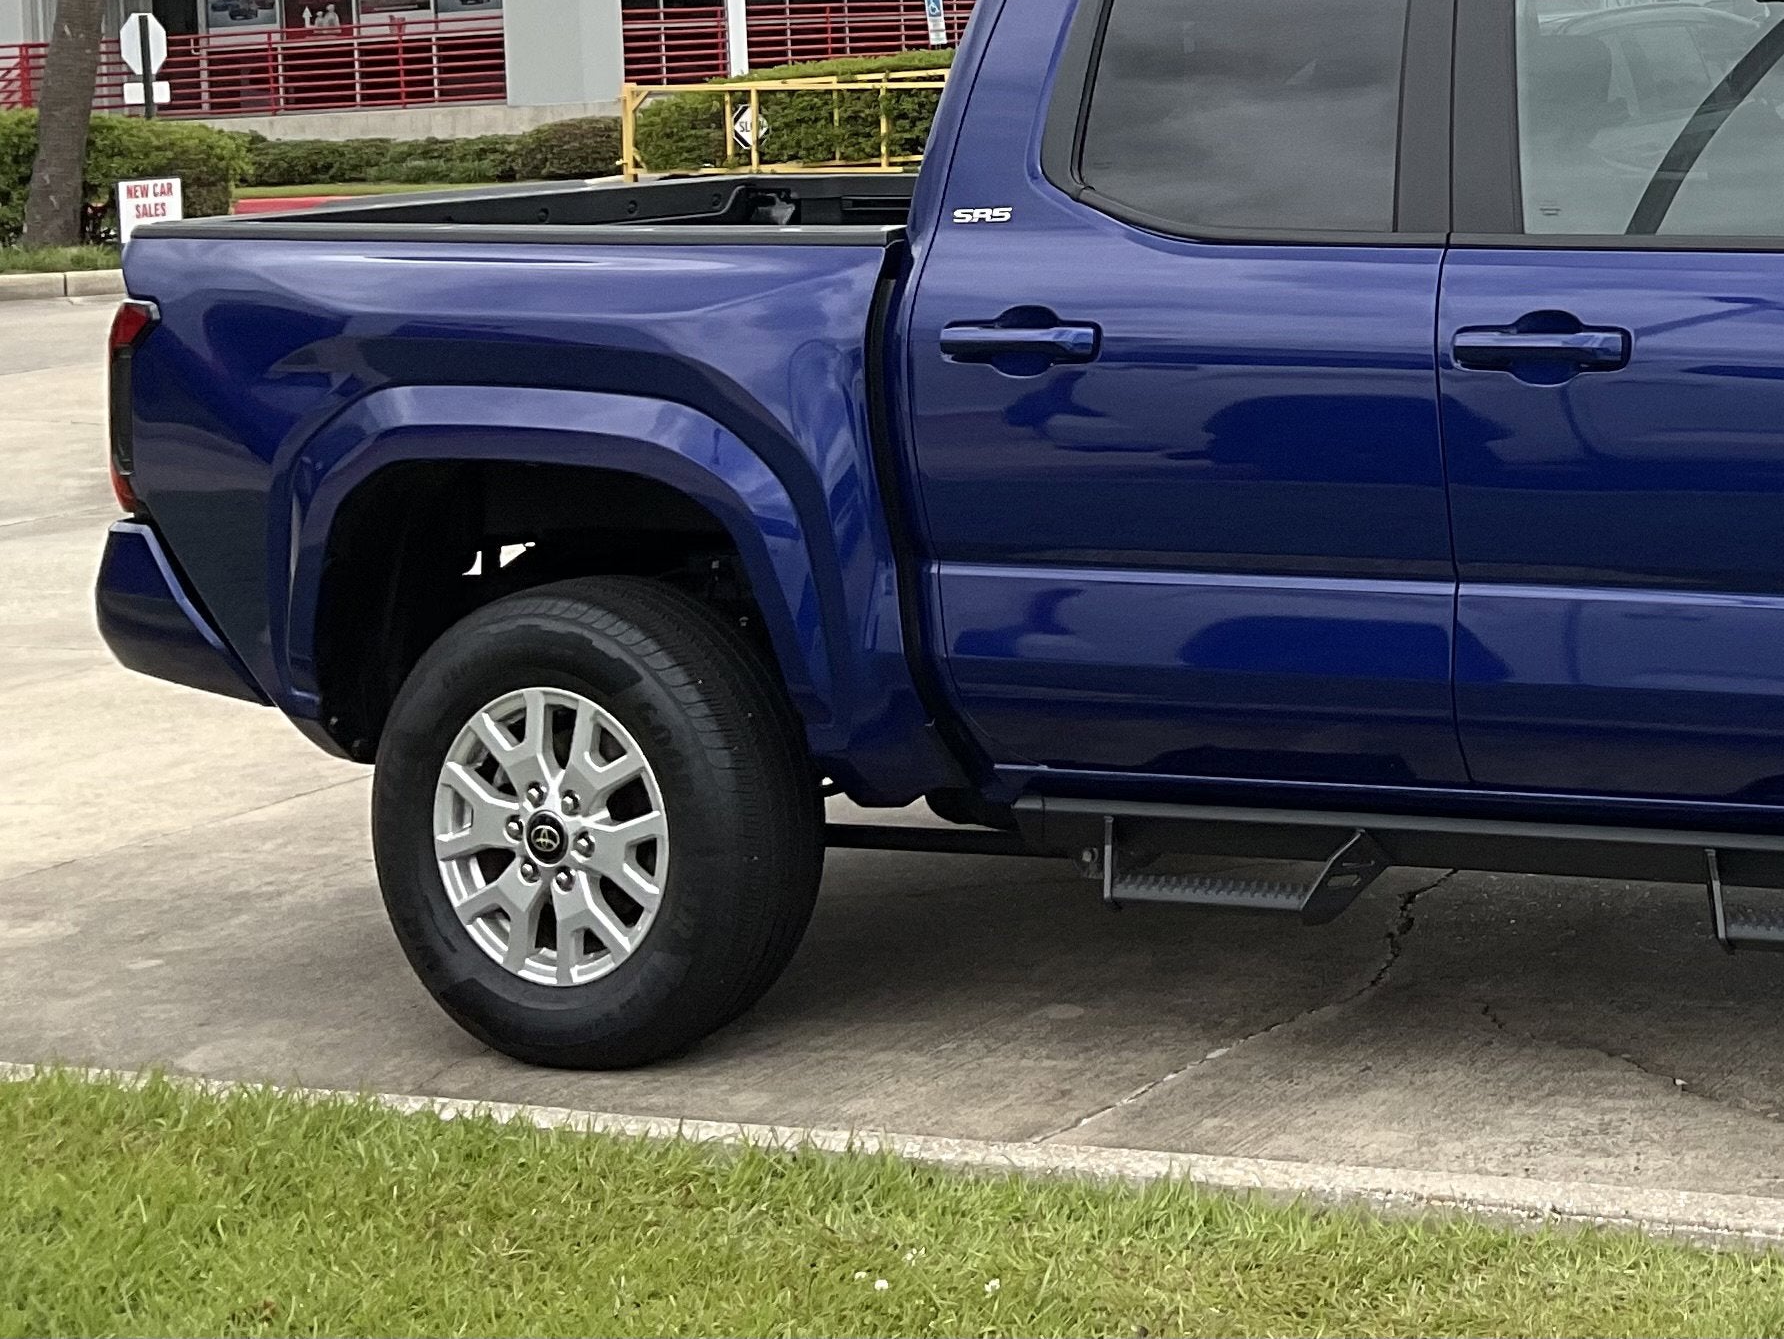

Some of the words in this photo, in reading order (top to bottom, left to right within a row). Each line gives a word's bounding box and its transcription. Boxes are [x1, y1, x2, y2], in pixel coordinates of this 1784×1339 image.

[126, 184, 149, 199] NEW
[152, 182, 174, 198] CAR
[135, 202, 167, 219] SALES
[952, 207, 1013, 223] SR5
